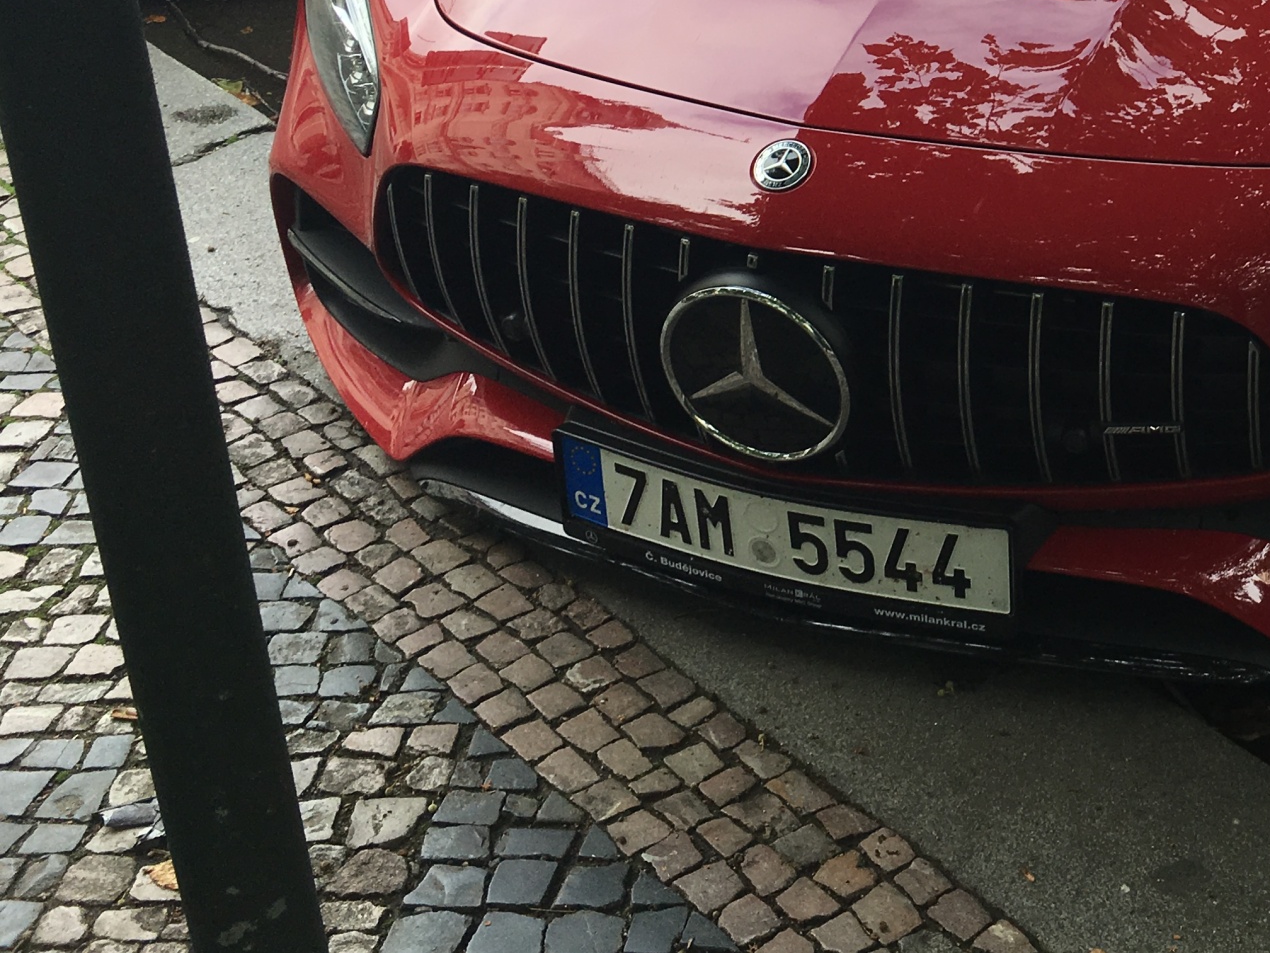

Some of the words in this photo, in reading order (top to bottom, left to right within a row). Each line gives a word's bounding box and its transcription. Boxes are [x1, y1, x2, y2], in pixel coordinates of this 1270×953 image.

[574, 490, 602, 515] CZ
[613, 462, 735, 557] 7AM
[787, 510, 972, 599] 5544
[661, 556, 723, 583] Budějovice
[874, 607, 986, 632] www.milankral.cz
